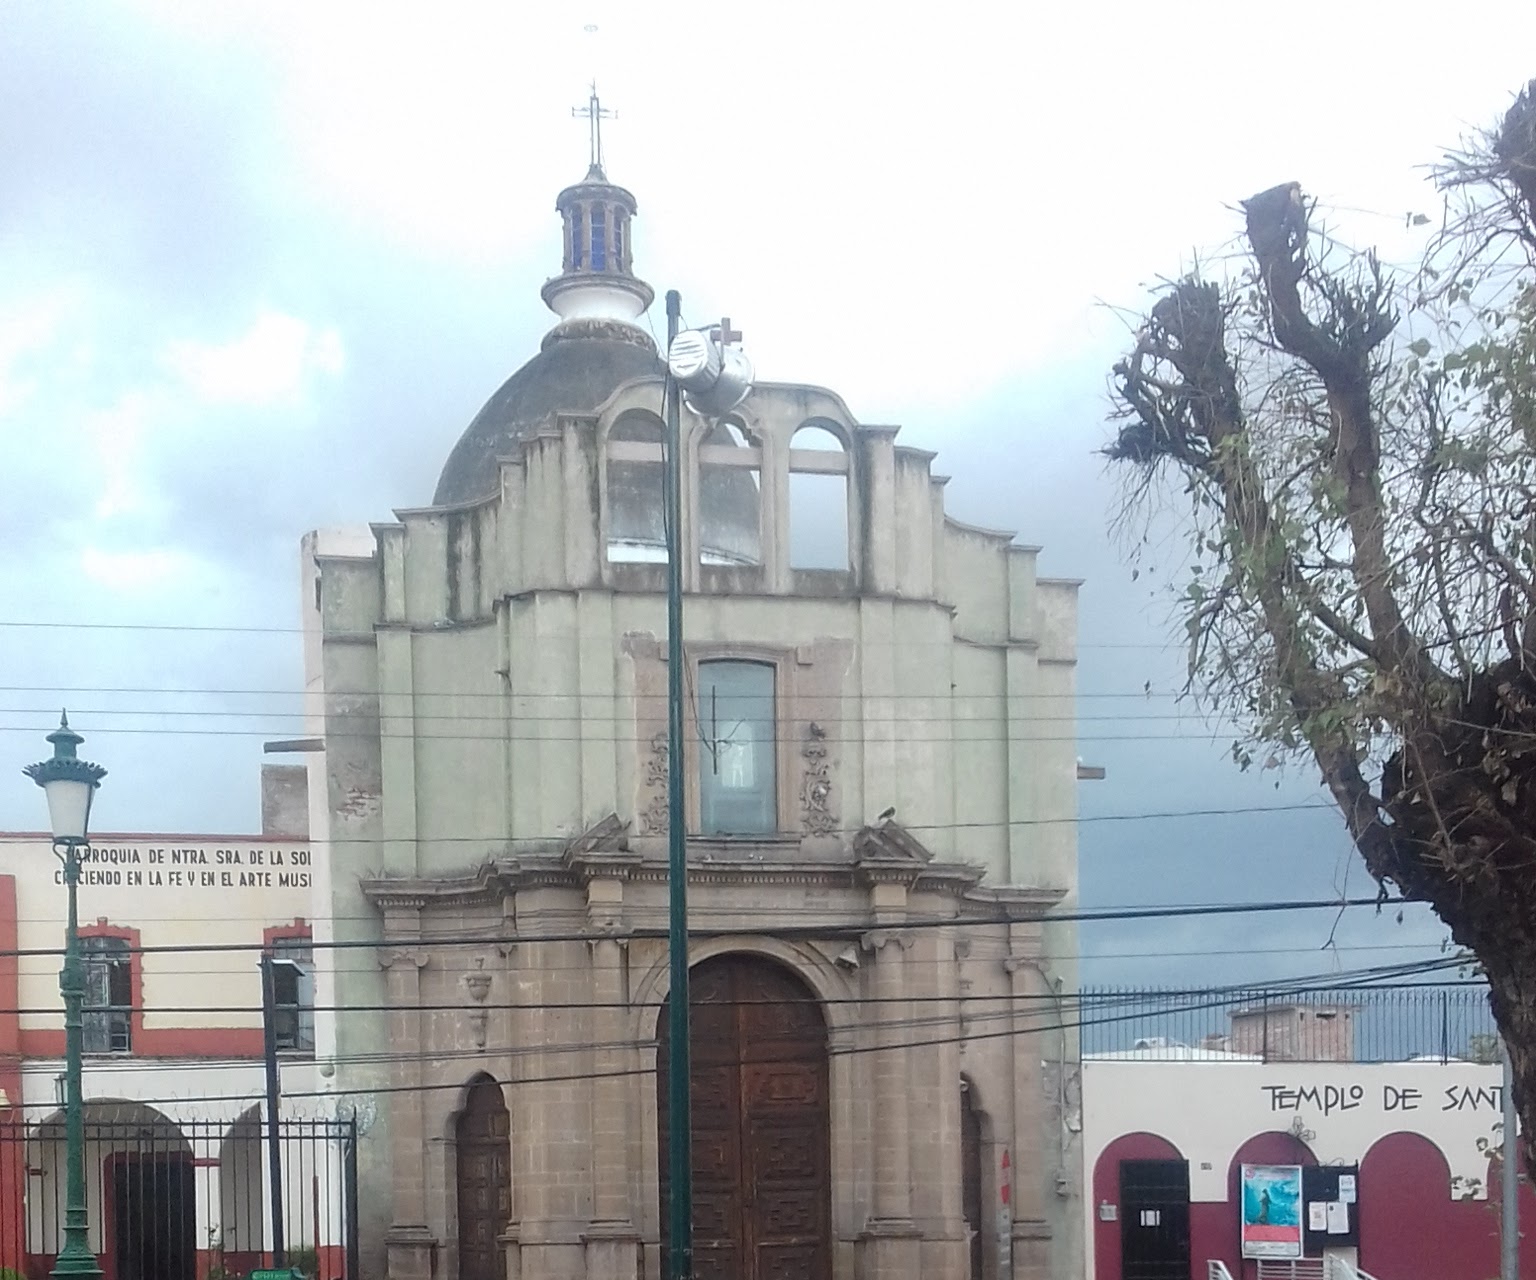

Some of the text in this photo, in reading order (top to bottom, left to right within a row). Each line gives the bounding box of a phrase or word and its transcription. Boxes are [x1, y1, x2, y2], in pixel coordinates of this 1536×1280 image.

[73, 848, 141, 865] ARROQUIA
[149, 849, 164, 863] DE
[250, 850, 264, 865] DE
[270, 851, 284, 866] LA
[54, 870, 121, 885] CCIENDO
[127, 871, 142, 885] EN
[149, 871, 162, 886] LA
[169, 871, 182, 886] FE
[188, 871, 195, 886] Y
[201, 872, 215, 886] EN
[221, 872, 234, 887] EL
[239, 872, 271, 887] ARTE
[1261, 1085, 1364, 1116] TEMPLO
[1384, 1086, 1422, 1111] DE
